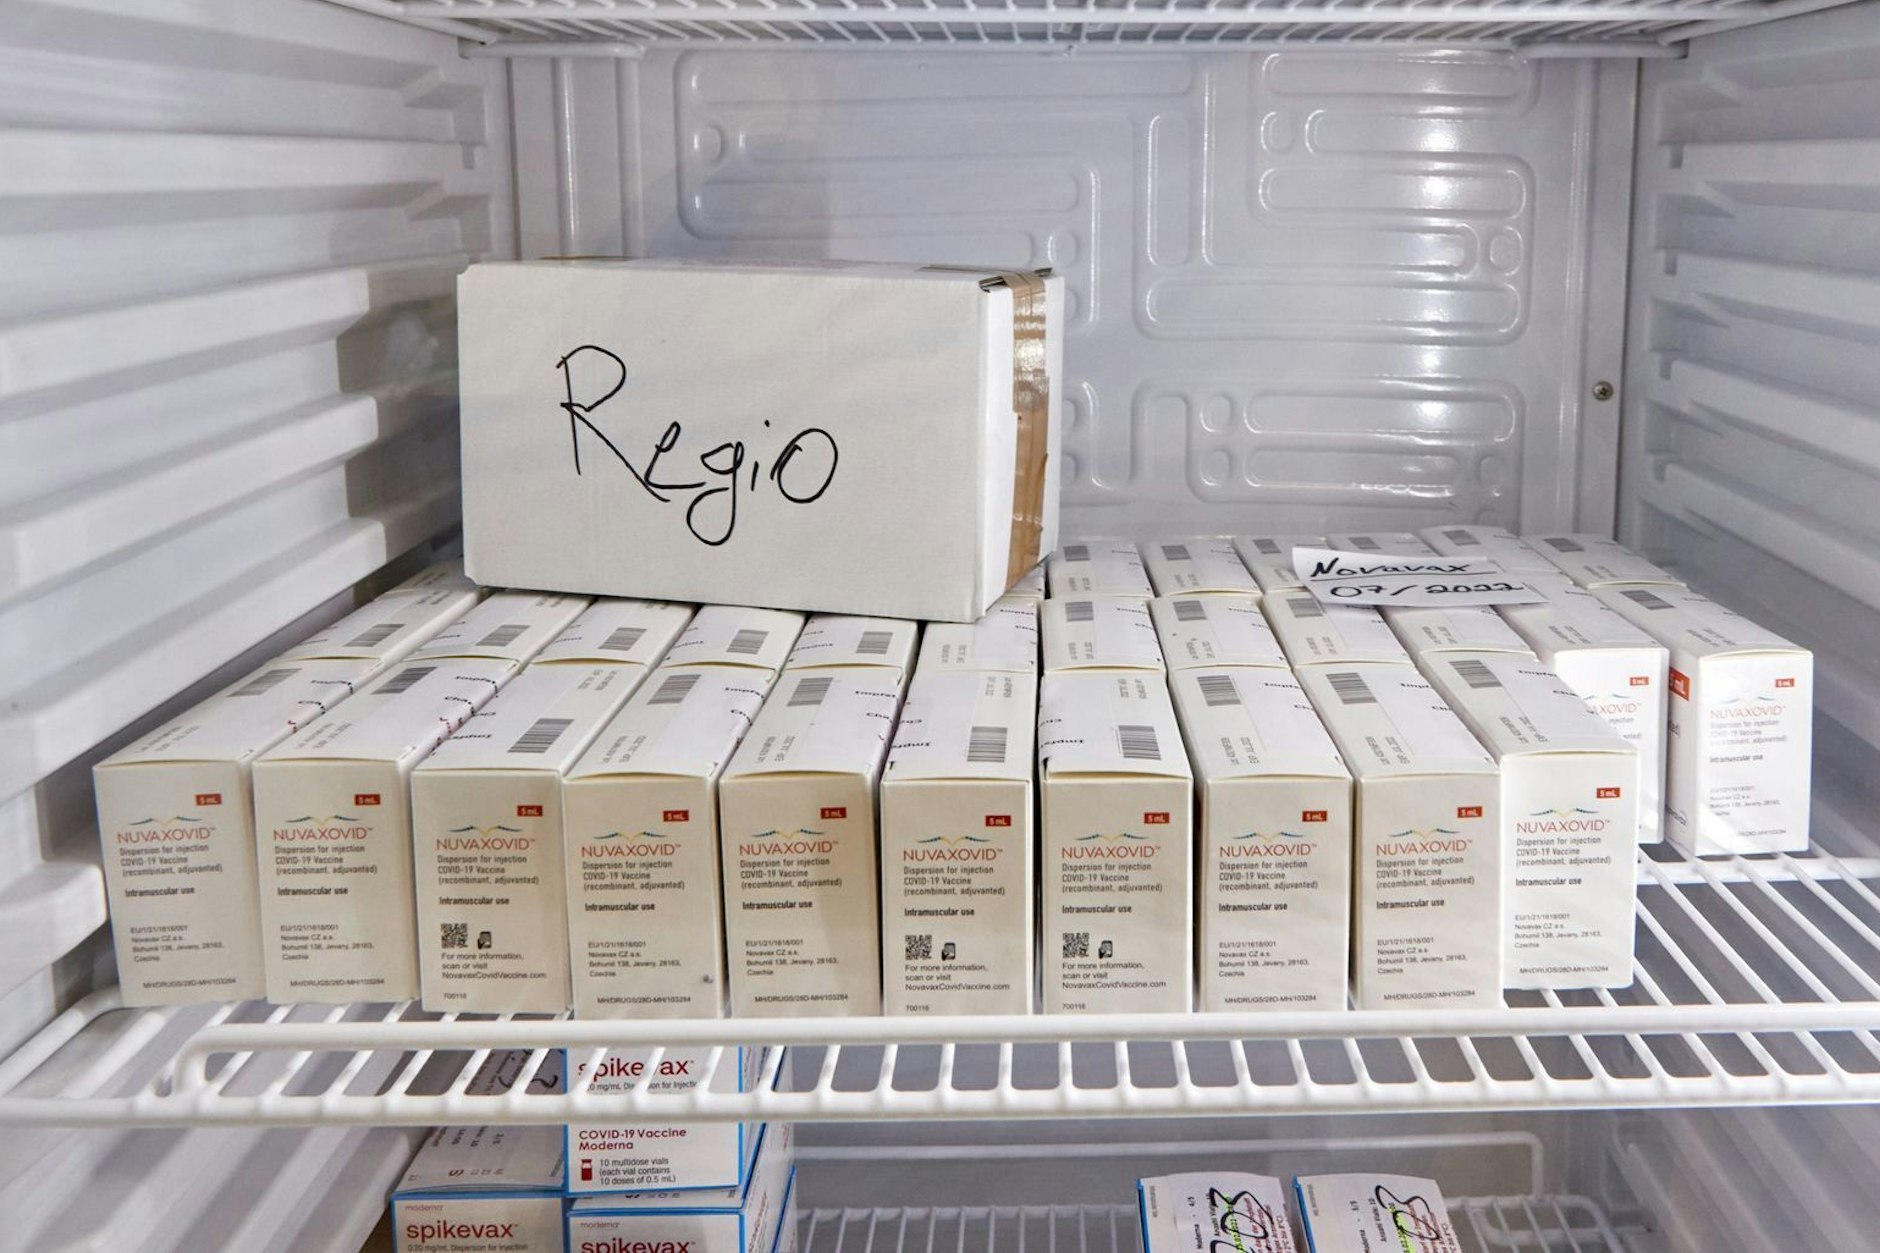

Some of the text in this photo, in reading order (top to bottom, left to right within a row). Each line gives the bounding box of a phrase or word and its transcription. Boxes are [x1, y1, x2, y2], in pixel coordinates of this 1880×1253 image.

[556, 345, 838, 545] Regio
[1310, 557, 1470, 578] Novavax
[1516, 838, 1554, 846] Dispersion
[1570, 836, 1601, 844] injection
[120, 848, 159, 856] Dispersion
[176, 845, 209, 853] injection
[275, 846, 314, 854] Dispersion
[331, 845, 365, 853] injection
[121, 858, 156, 866] COVID-19
[275, 856, 311, 864] COVID-19
[438, 855, 478, 864] Dispersion
[494, 855, 527, 864] injection
[740, 860, 780, 868] Dispersion
[797, 858, 830, 866] injection
[1376, 860, 1415, 868] Dispersion
[1431, 857, 1464, 865] injection
[1569, 856, 1611, 866] adjuvanted)
[178, 865, 222, 874] adjuvanted)
[332, 865, 377, 875] adjuvanted)
[583, 862, 622, 870] Dispersion
[639, 861, 672, 869] injection
[1062, 864, 1102, 872] Dispersion
[1119, 863, 1151, 872] injection
[1220, 862, 1258, 870] Dispersion
[1275, 861, 1308, 869] injection
[740, 870, 776, 878] COVID-19
[904, 866, 944, 875] Dispersion
[961, 866, 994, 875] injection
[495, 876, 539, 885] adjuvanted)
[583, 872, 618, 880] COVID-19
[1219, 872, 1254, 880] COVID-19
[640, 881, 685, 891] adjuvanted)
[797, 879, 842, 888] adjuvanted)
[1274, 881, 1318, 891] adjuvanted)
[1431, 877, 1474, 887] adjuvanted)
[1516, 877, 1566, 886] Intramuscular
[125, 887, 178, 897] Intramuscular
[278, 886, 331, 896] Intramuscular
[961, 887, 1005, 896] adjuvanted)
[1118, 884, 1162, 893] adjuvanted)
[440, 896, 493, 905] Intramuscular
[743, 900, 796, 910] Intramuscular
[1377, 899, 1428, 909] Intramuscular
[585, 902, 638, 912] Intramuscular
[1062, 905, 1116, 913] Intramuscular
[1219, 902, 1271, 912] Intramuscular
[905, 908, 958, 916] Intramuscular
[579, 1128, 686, 1139] COVID-19 Vaccine
[579, 1141, 633, 1150] Moderna
[612, 1158, 649, 1166] multidose
[600, 1168, 620, 1176] (each
[638, 1166, 670, 1174] contains
[612, 1177, 634, 1185] doses
[637, 1176, 644, 1184] of
[646, 1175, 659, 1183] 0.5
[661, 1175, 676, 1183] mL)
